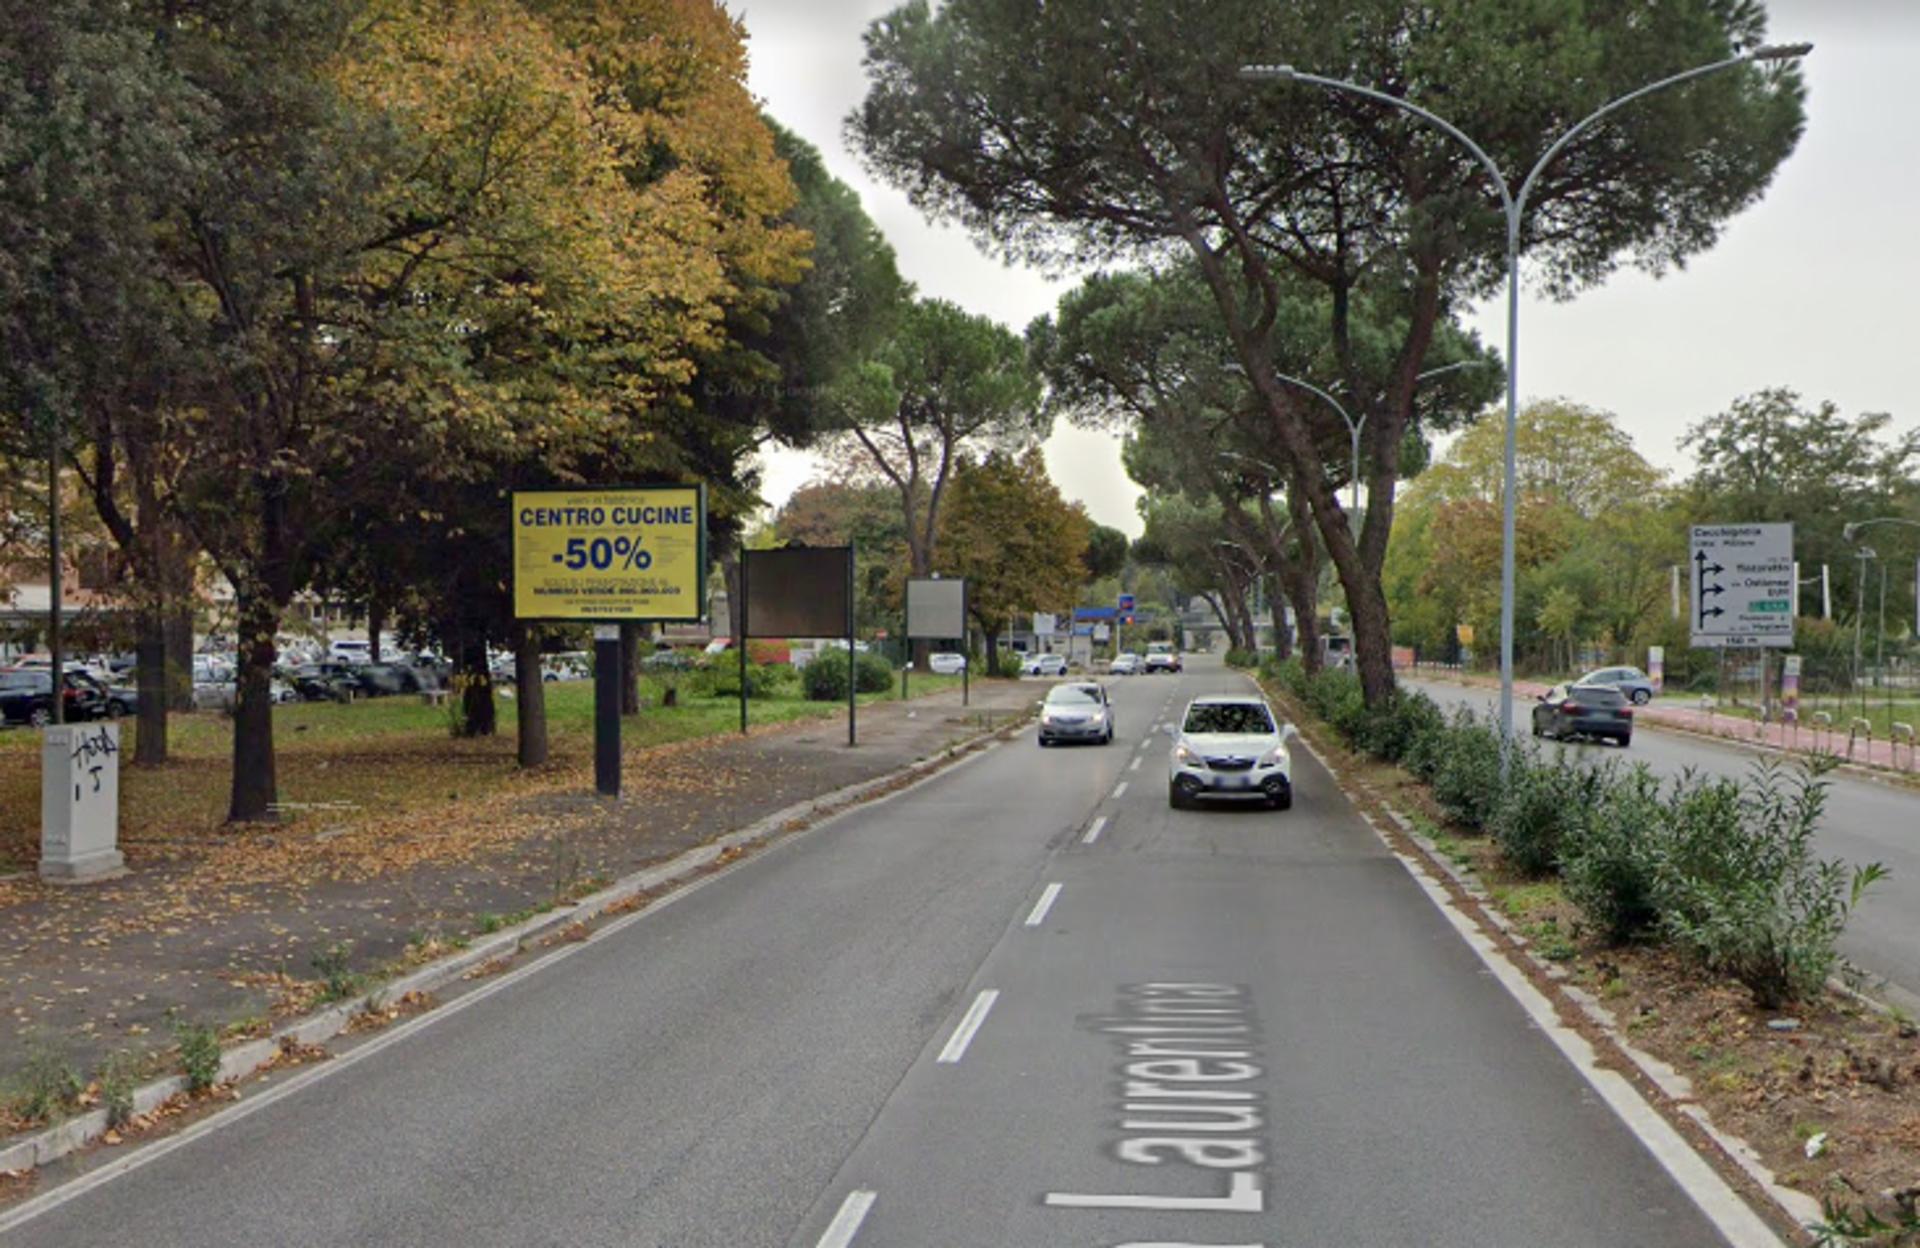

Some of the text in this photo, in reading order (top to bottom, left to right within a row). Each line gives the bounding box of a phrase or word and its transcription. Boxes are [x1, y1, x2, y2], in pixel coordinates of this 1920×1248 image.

[519, 506, 694, 526] CENTRO CUCINE
[552, 535, 652, 570] -50%
[1043, 982, 1265, 1212] Laurentina
